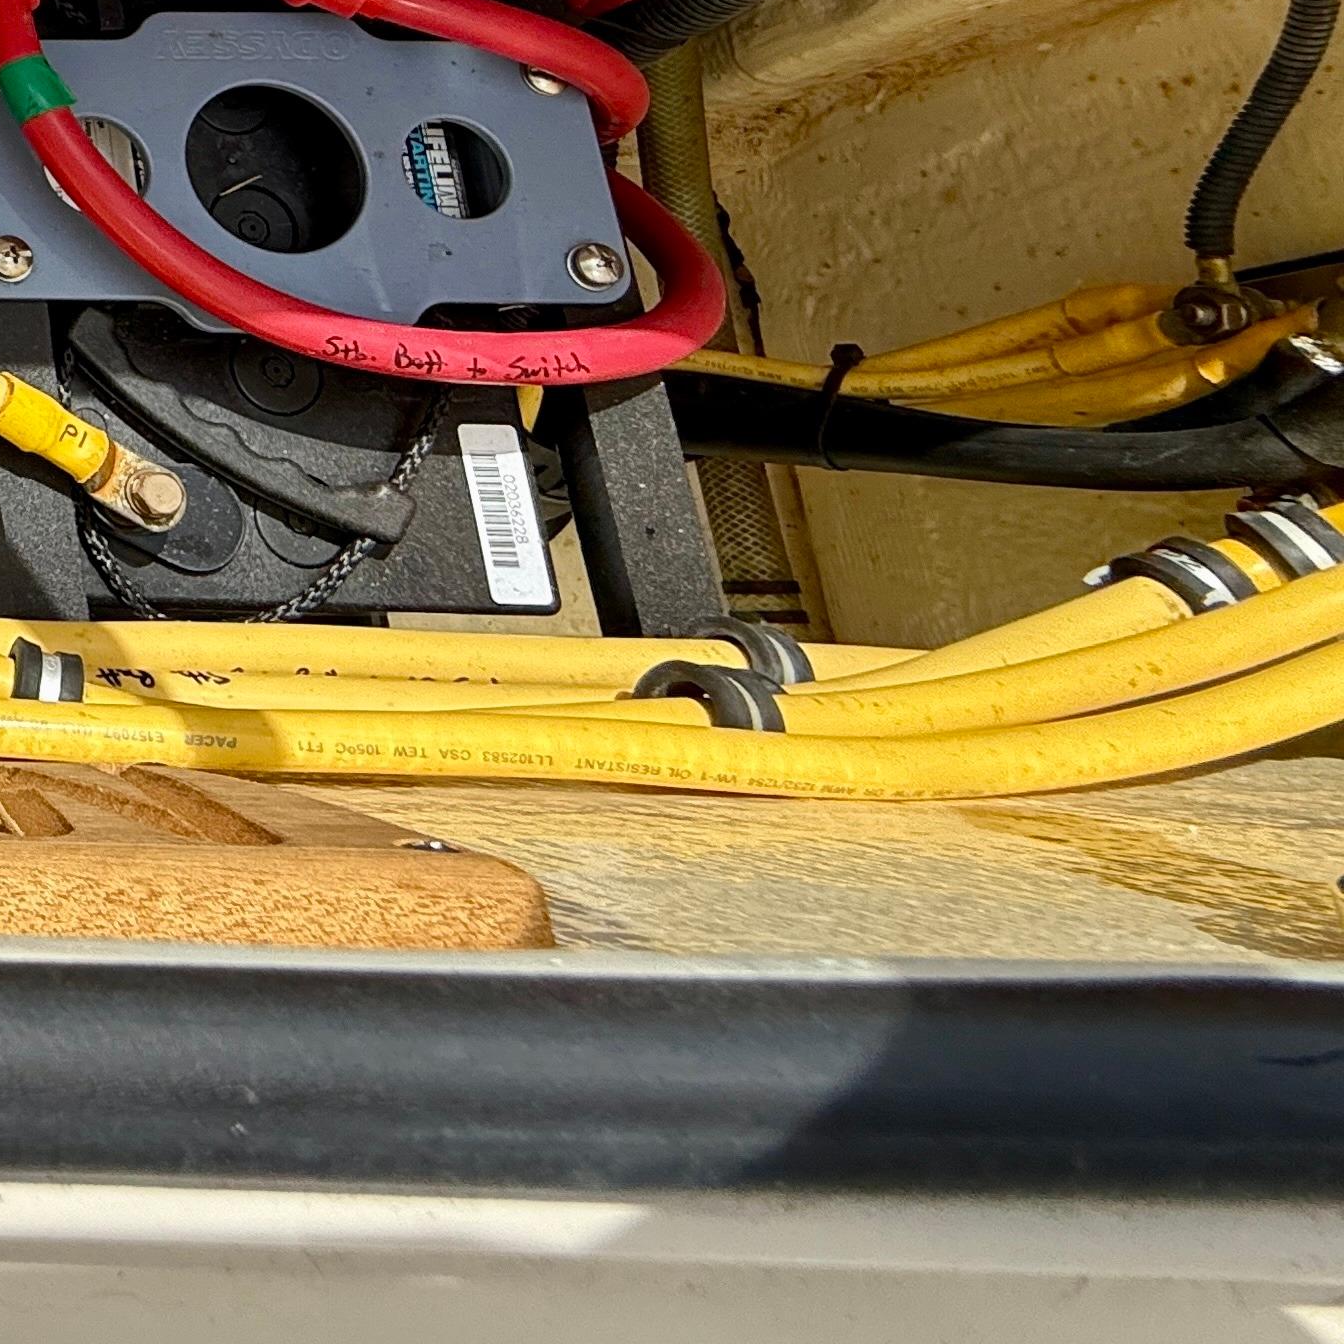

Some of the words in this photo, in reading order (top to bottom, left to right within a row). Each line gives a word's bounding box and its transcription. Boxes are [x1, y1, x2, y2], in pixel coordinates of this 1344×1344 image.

[466, 357, 488, 378] to
[507, 352, 590, 380] Switch
[502, 474, 529, 544] 02036228
[185, 734, 238, 749] PACER
[297, 739, 325, 754] FT1
[392, 744, 428, 758] TEW
[439, 748, 472, 762] CSA
[575, 758, 662, 776] RESISTANT
